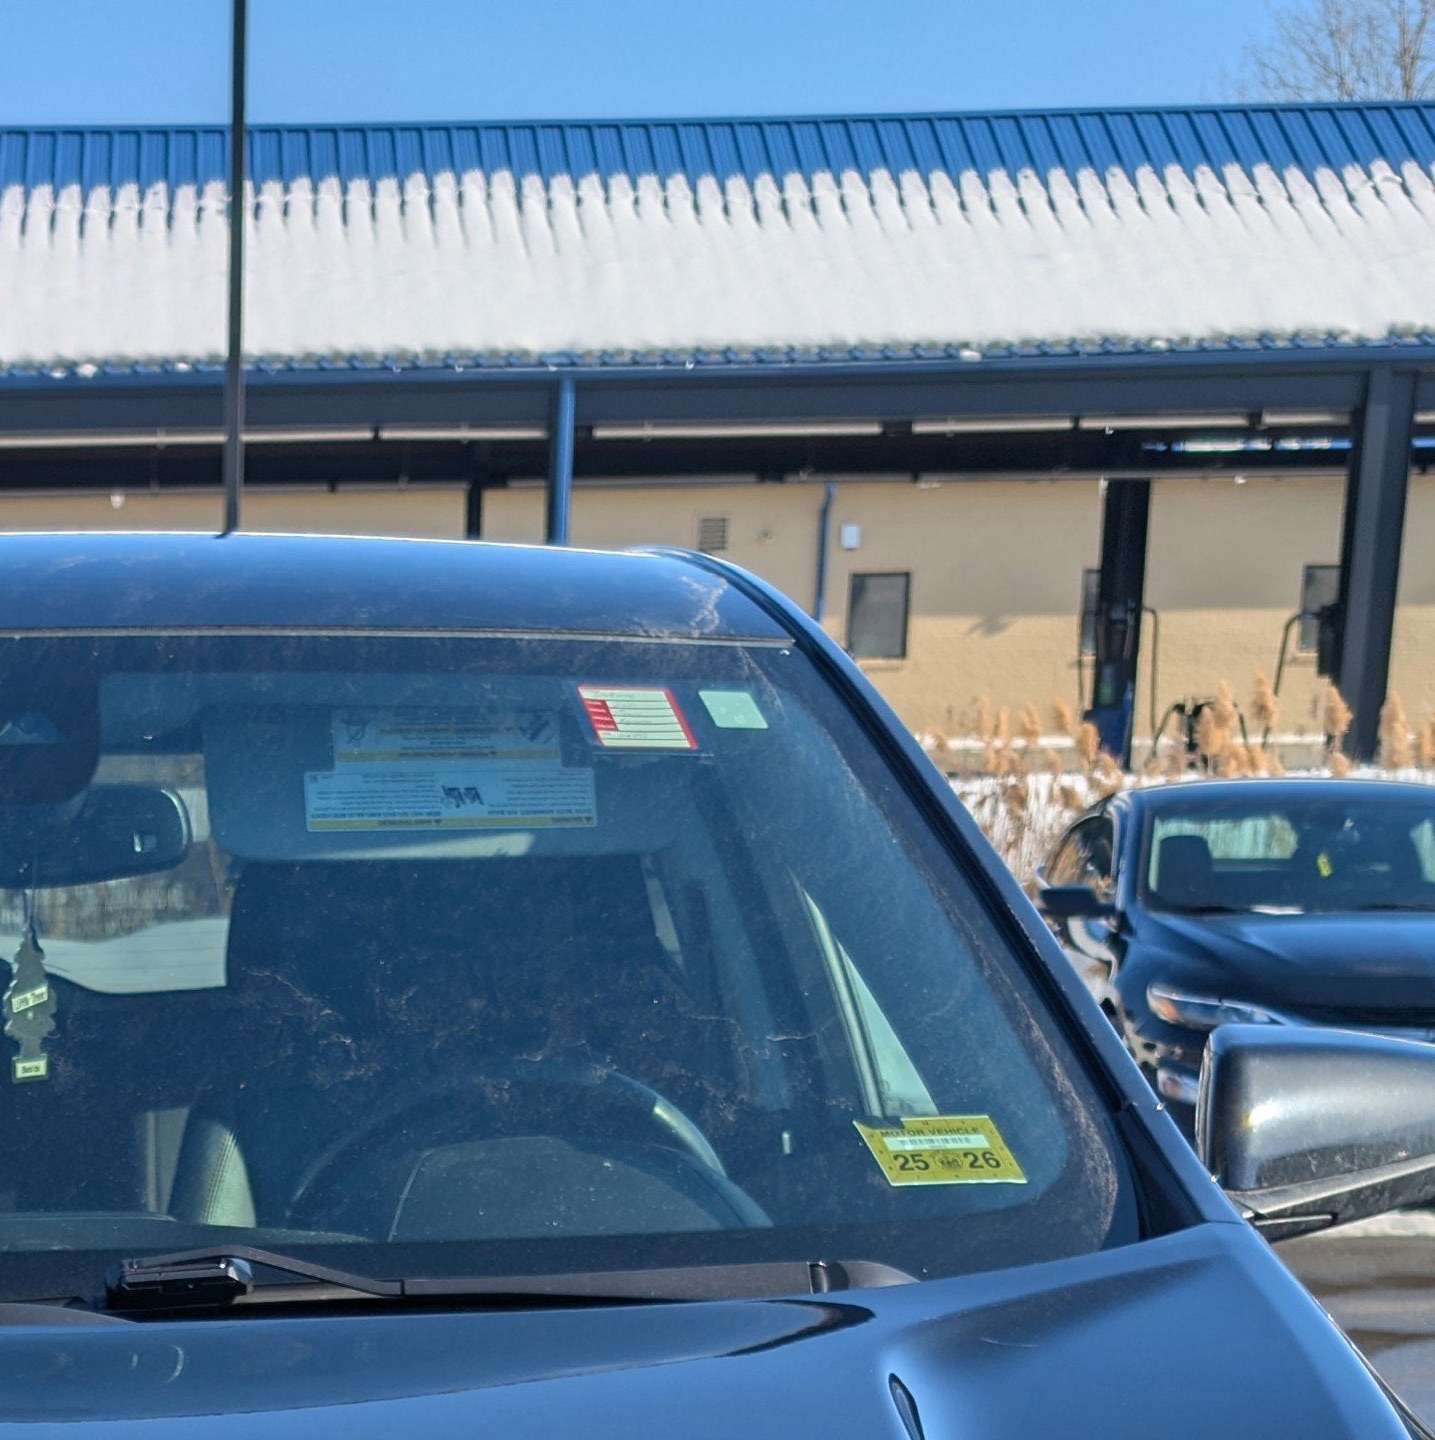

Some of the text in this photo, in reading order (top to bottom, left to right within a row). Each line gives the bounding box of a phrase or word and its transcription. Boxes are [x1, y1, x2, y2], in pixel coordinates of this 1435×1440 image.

[882, 1127, 980, 1137] MOTOR VEHICLE
[893, 1153, 930, 1171] 25
[963, 1152, 1001, 1169] 26
